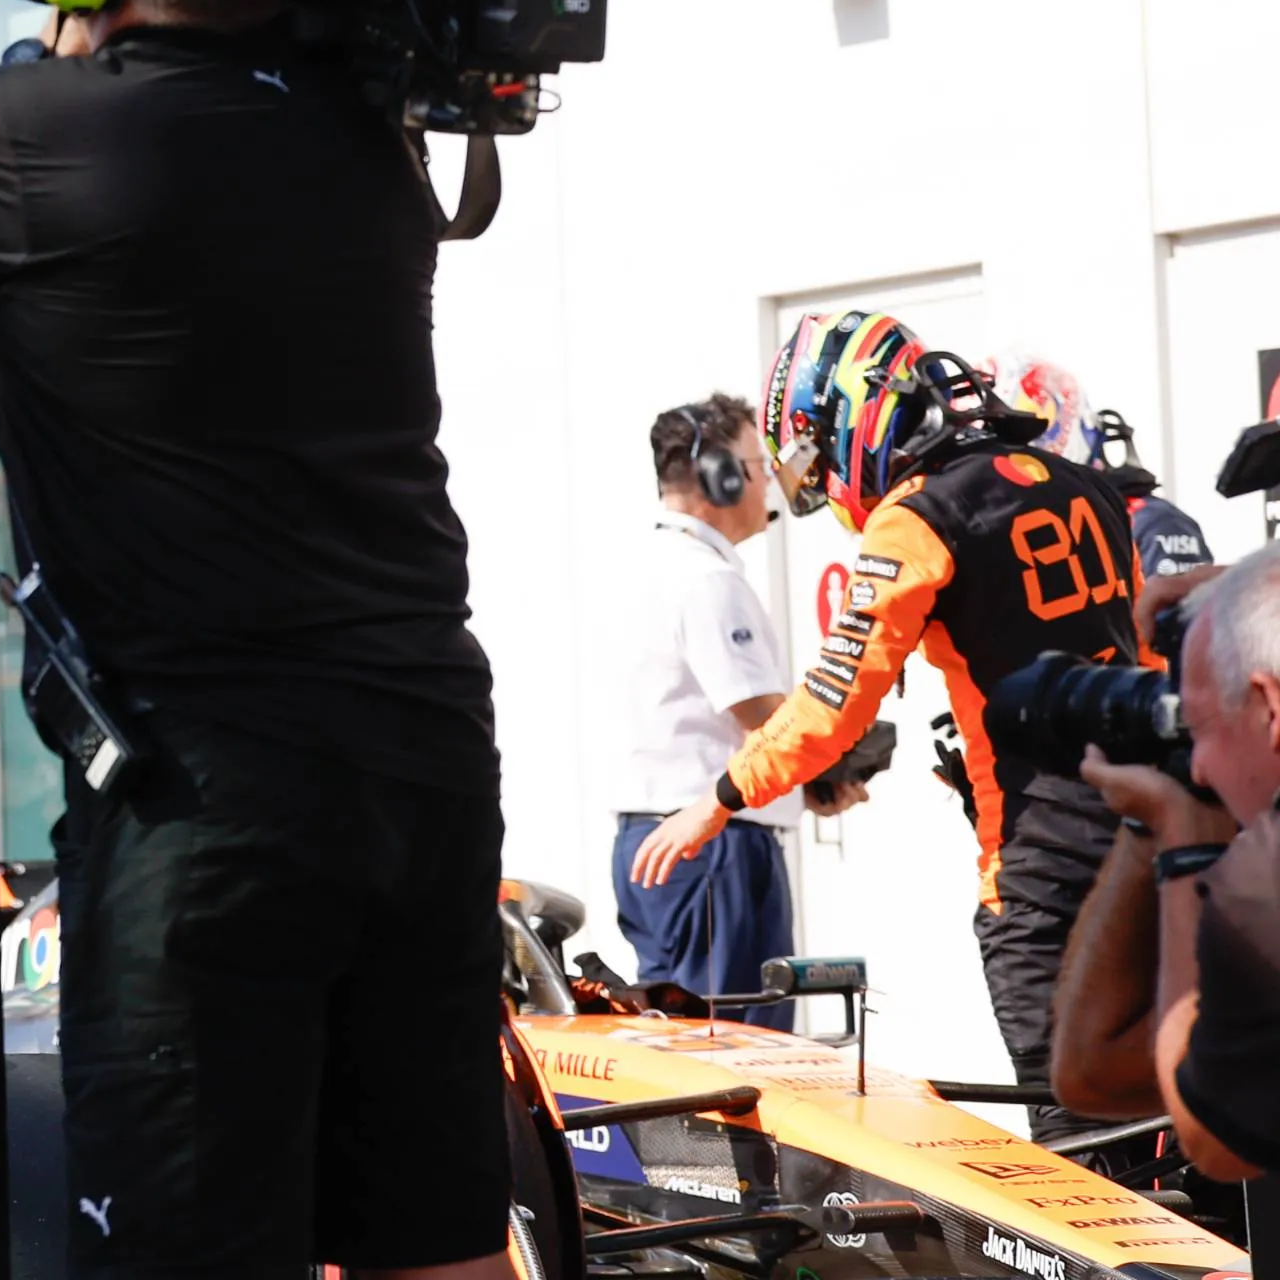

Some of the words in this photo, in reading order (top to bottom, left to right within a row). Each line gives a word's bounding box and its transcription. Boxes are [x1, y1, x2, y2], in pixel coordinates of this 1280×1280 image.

[1009, 496, 1130, 621] 81
[1155, 534, 1201, 554] VISA
[554, 1053, 618, 1082] MILLE
[663, 1175, 742, 1205] McLaren
[1024, 1194, 1140, 1209] FxPro
